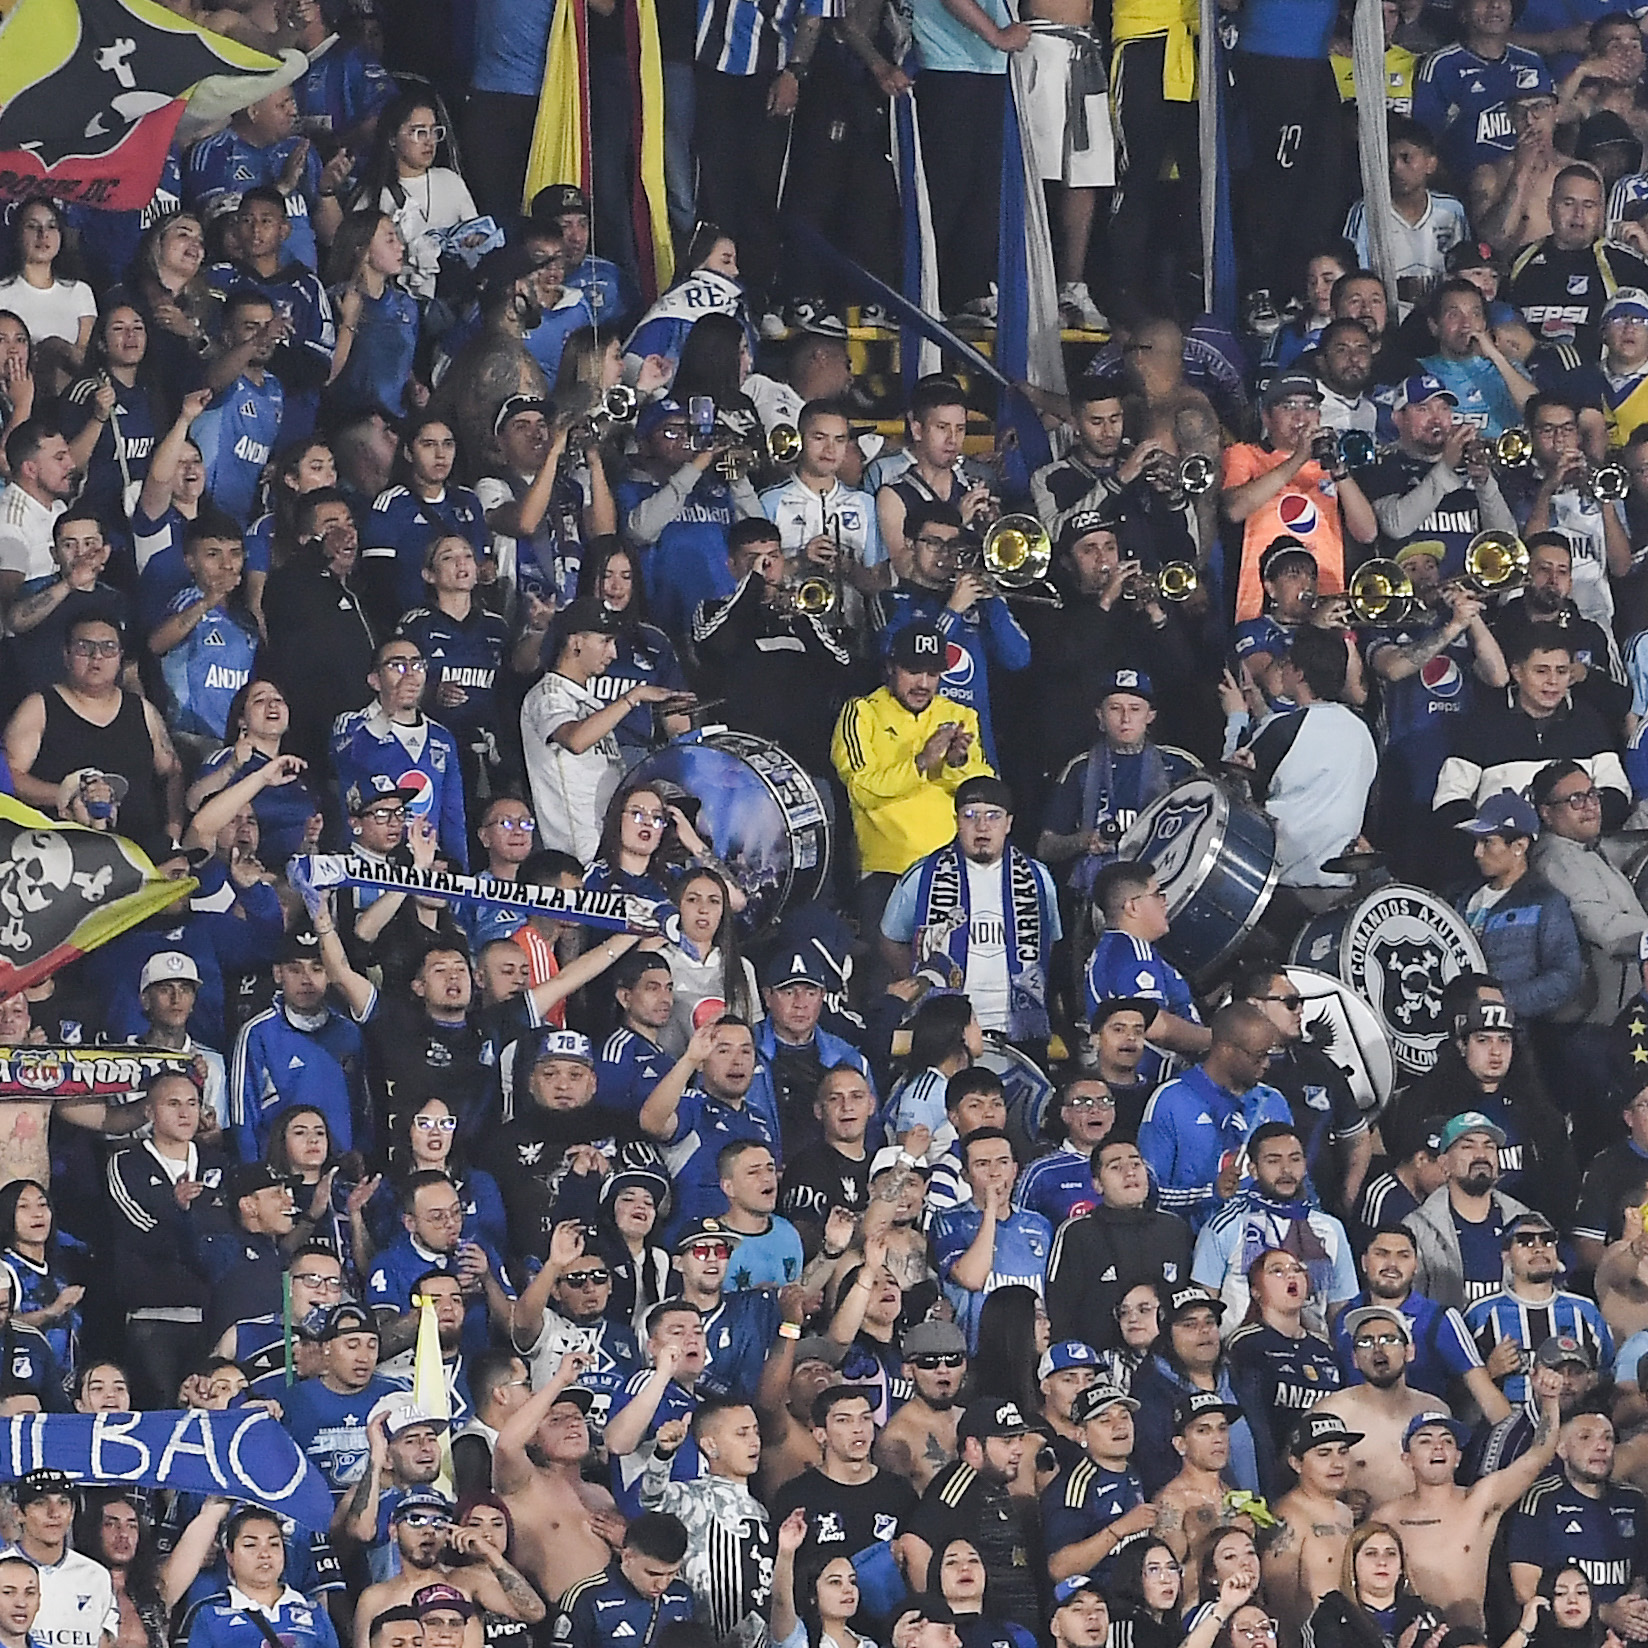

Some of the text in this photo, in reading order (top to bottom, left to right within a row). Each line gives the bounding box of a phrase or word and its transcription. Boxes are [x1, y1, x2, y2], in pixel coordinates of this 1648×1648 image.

[345, 856, 463, 893] CARNAVAL
[572, 891, 626, 918] VIDA
[1352, 899, 1471, 976] COMANDOS AZULES
[371, 1269, 386, 1292] 4
